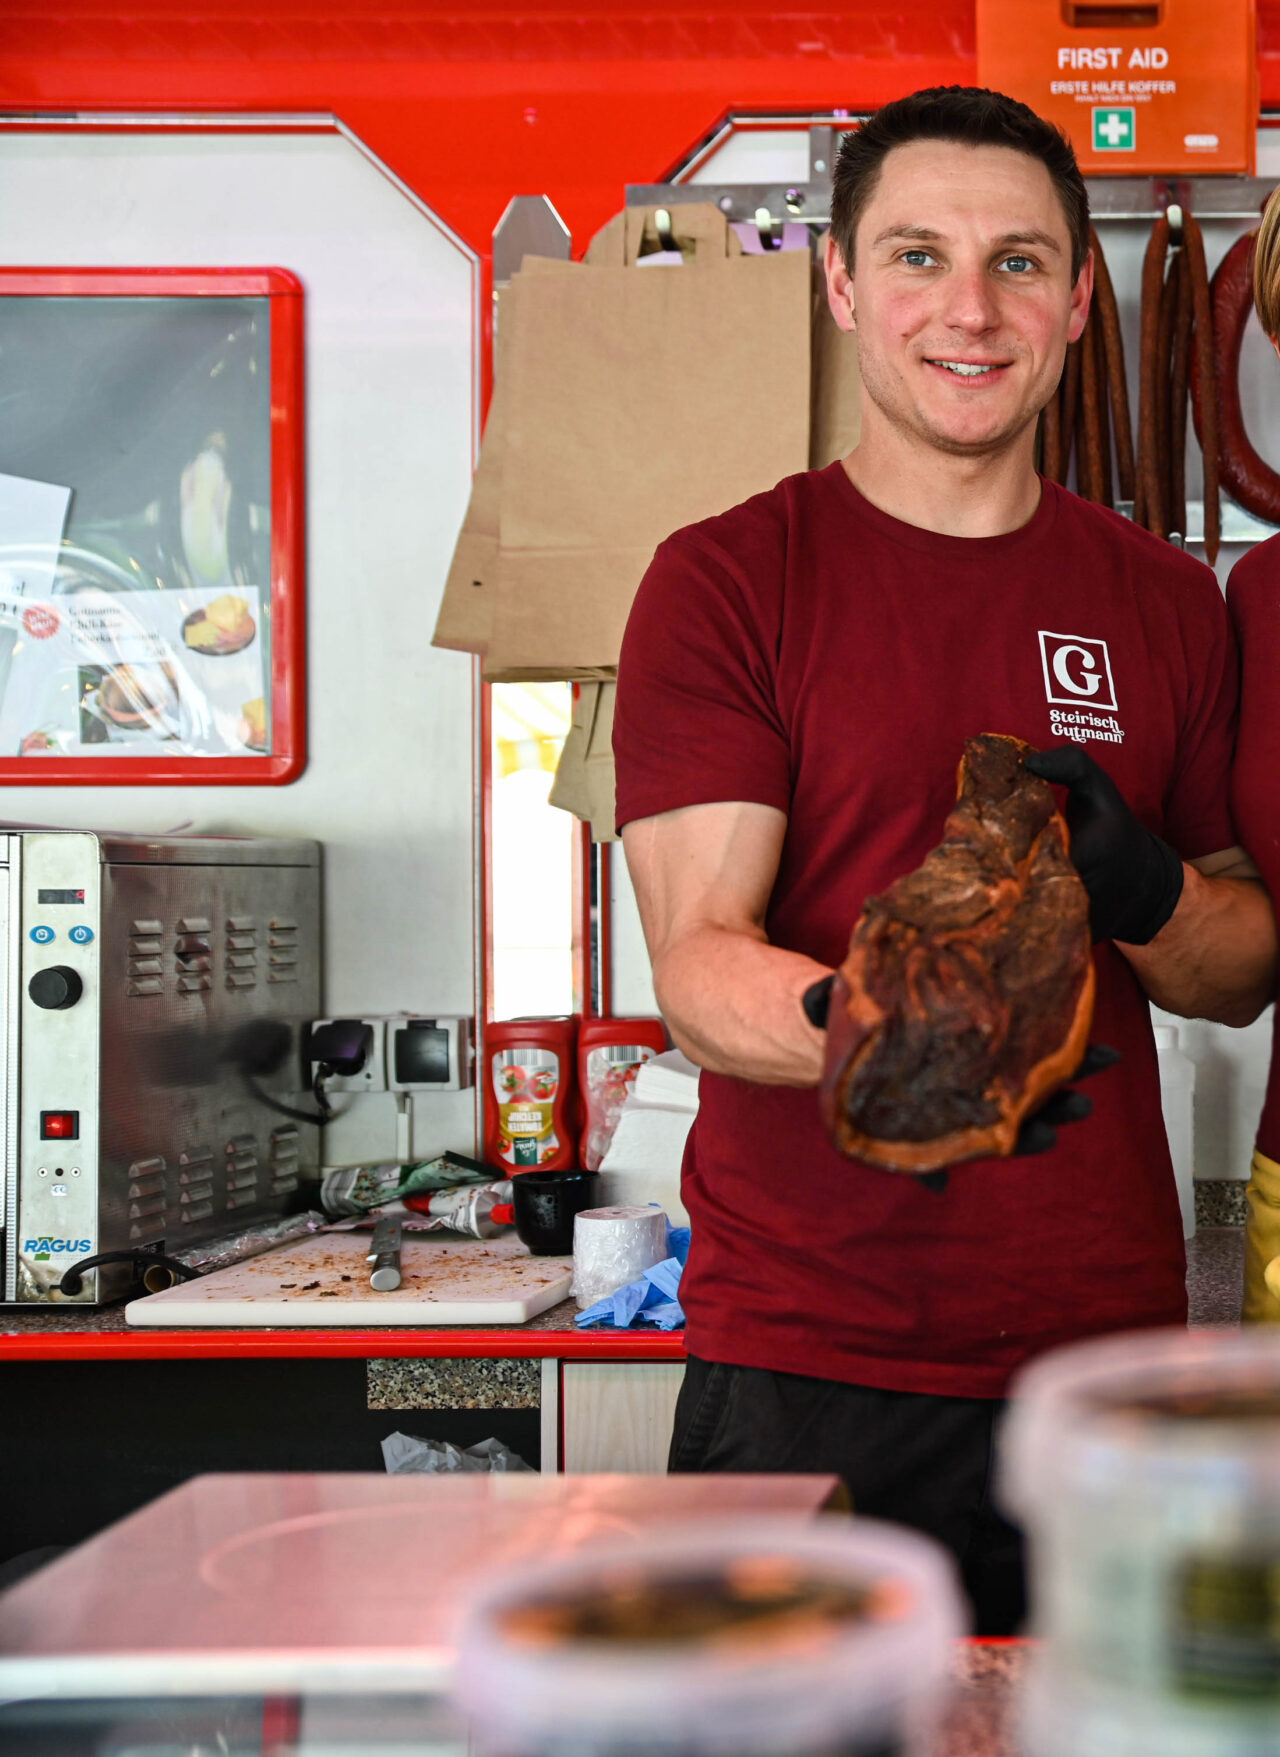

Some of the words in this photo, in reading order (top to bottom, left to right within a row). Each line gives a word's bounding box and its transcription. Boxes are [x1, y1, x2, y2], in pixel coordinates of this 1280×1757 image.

[1057, 47, 1122, 70] FIRST
[1129, 47, 1169, 70] AID
[1050, 80, 1089, 94] ERSTE
[1092, 80, 1126, 94] HILFE
[1128, 80, 1176, 94] KOFFER
[1052, 645, 1103, 696] G
[1049, 709, 1125, 737] Steirisch
[1050, 722, 1123, 744] Gutmann
[24, 1239, 91, 1253] RAGUS
